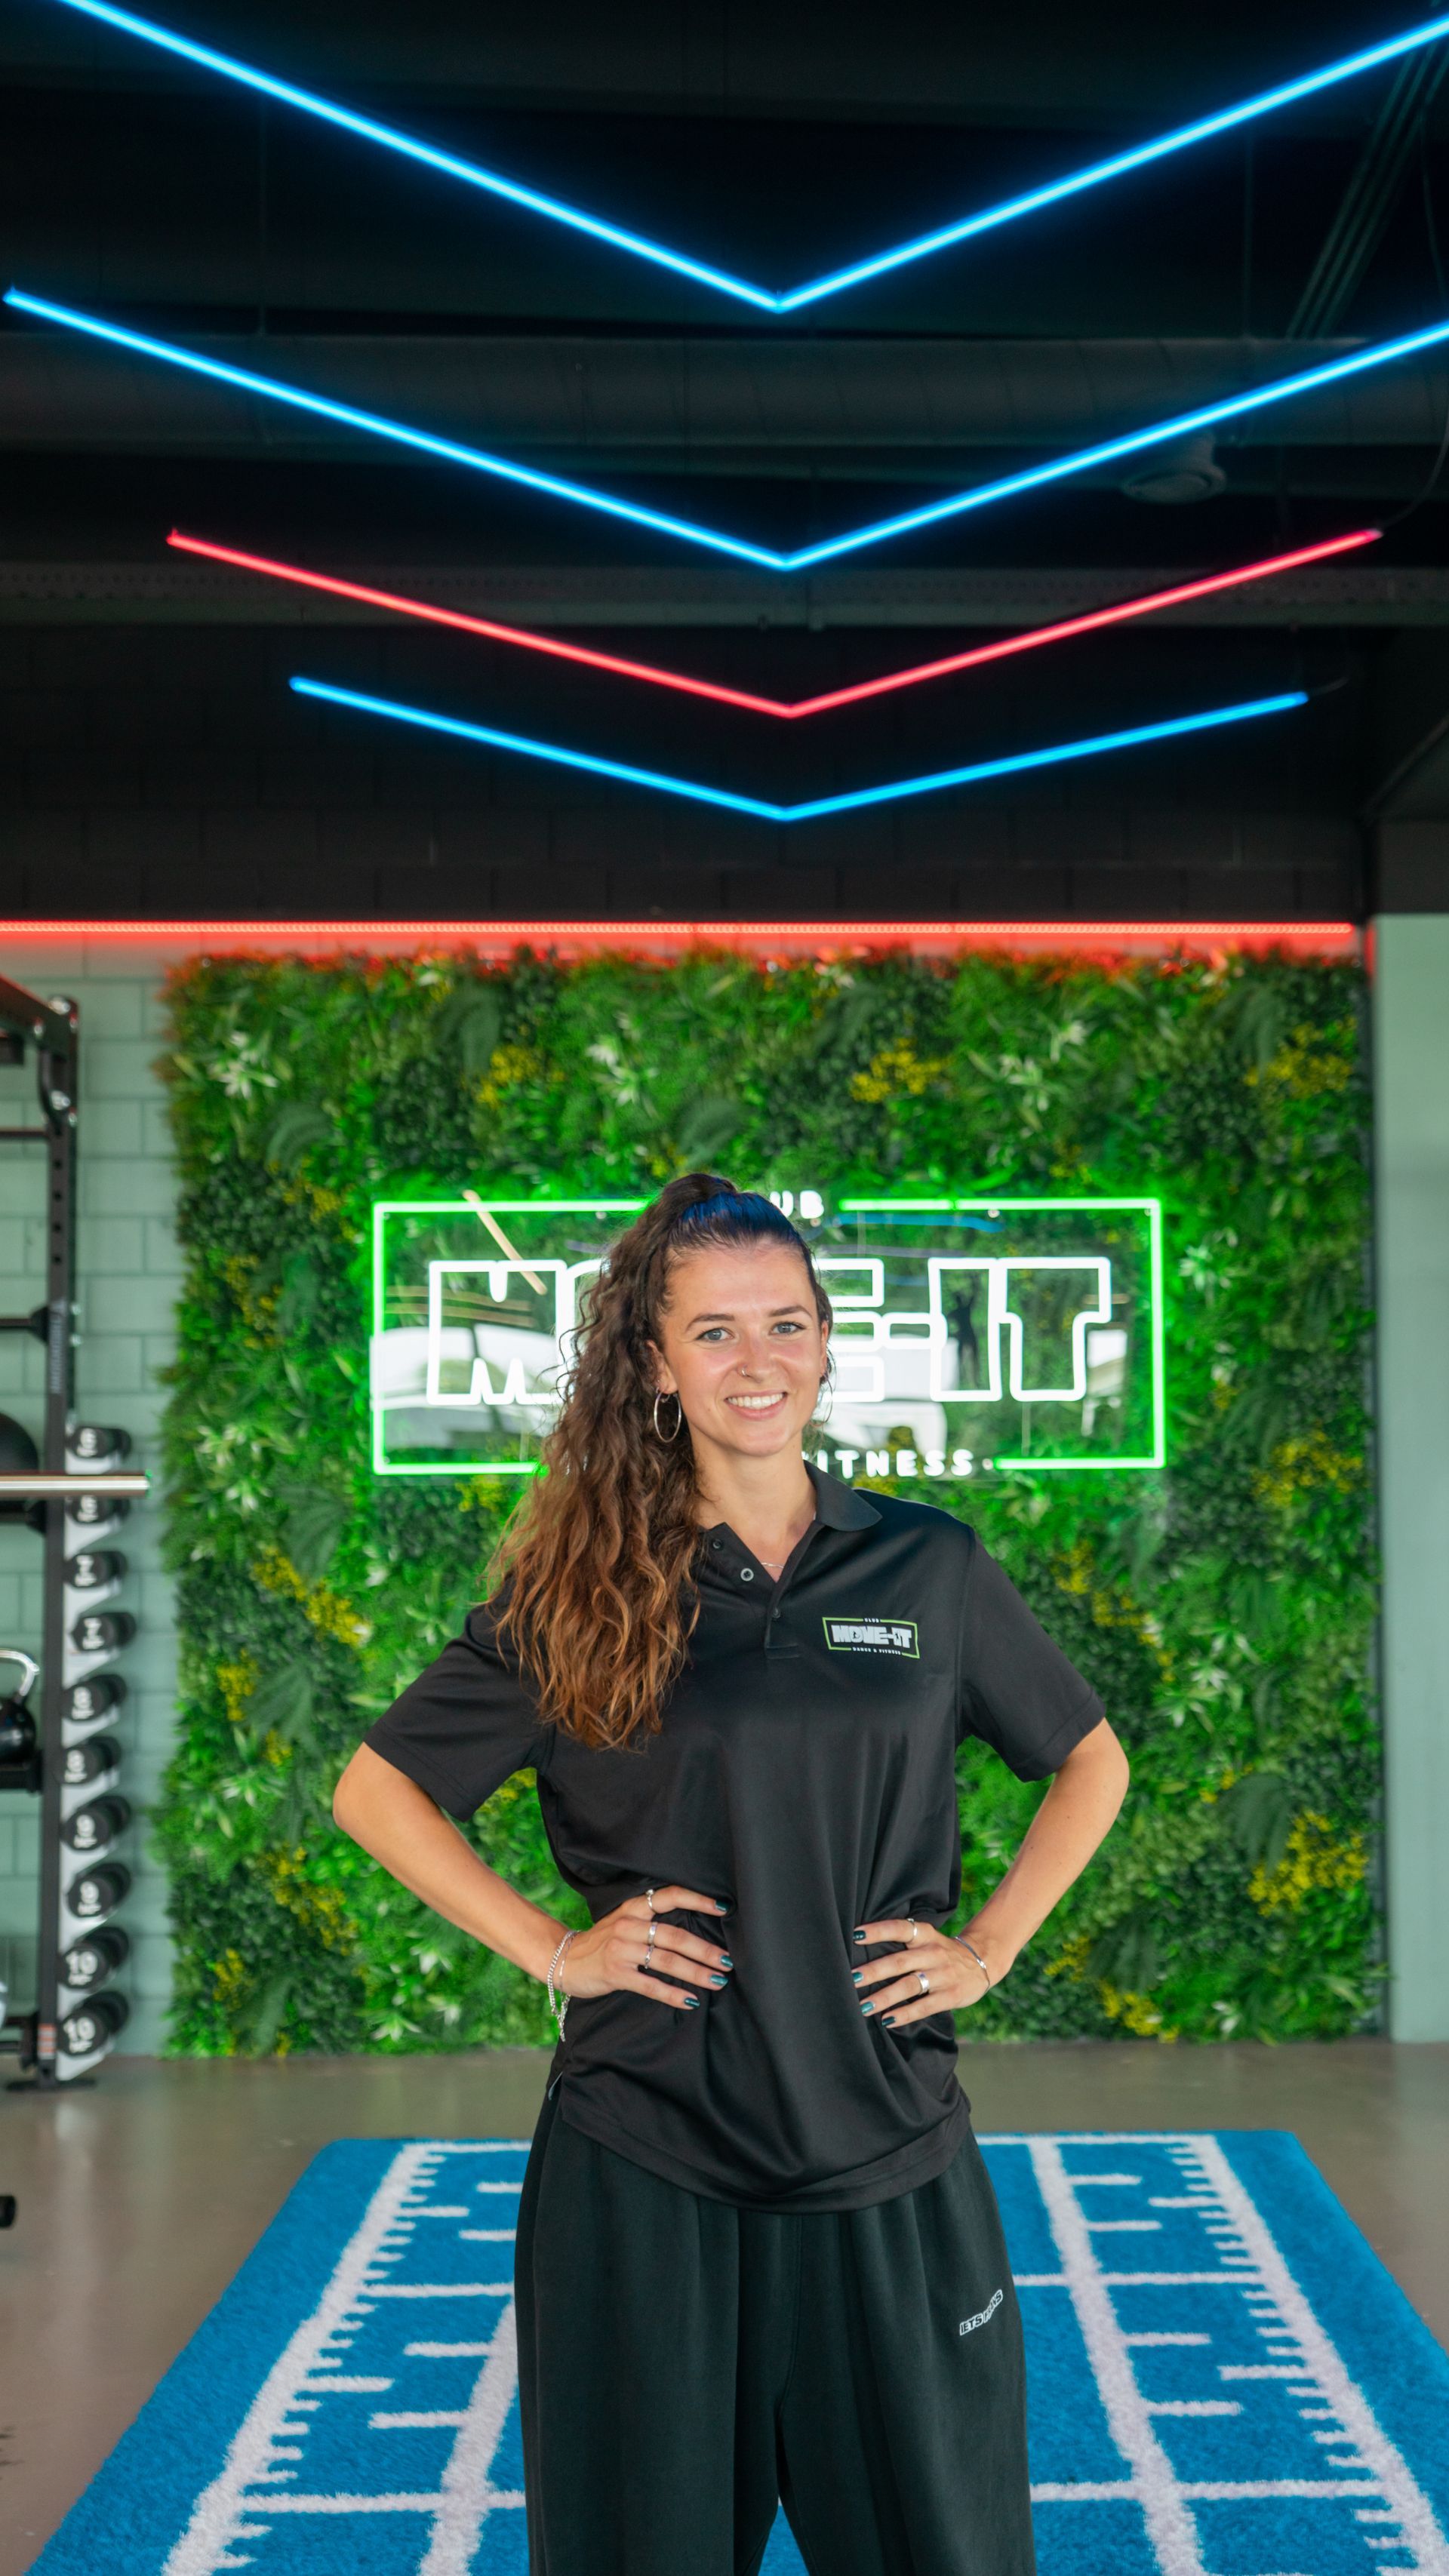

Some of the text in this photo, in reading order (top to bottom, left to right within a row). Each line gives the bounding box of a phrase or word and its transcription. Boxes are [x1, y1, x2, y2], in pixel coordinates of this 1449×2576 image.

[770, 1190, 824, 1219] UB
[427, 1256, 1112, 1406] ME-IT
[802, 1449, 974, 1479] ITNESS
[831, 1625, 912, 1649] MOVE-IT
[66, 1950, 98, 1975] 10
[63, 2017, 96, 2041] 10
[959, 2313, 984, 2336] IETS
